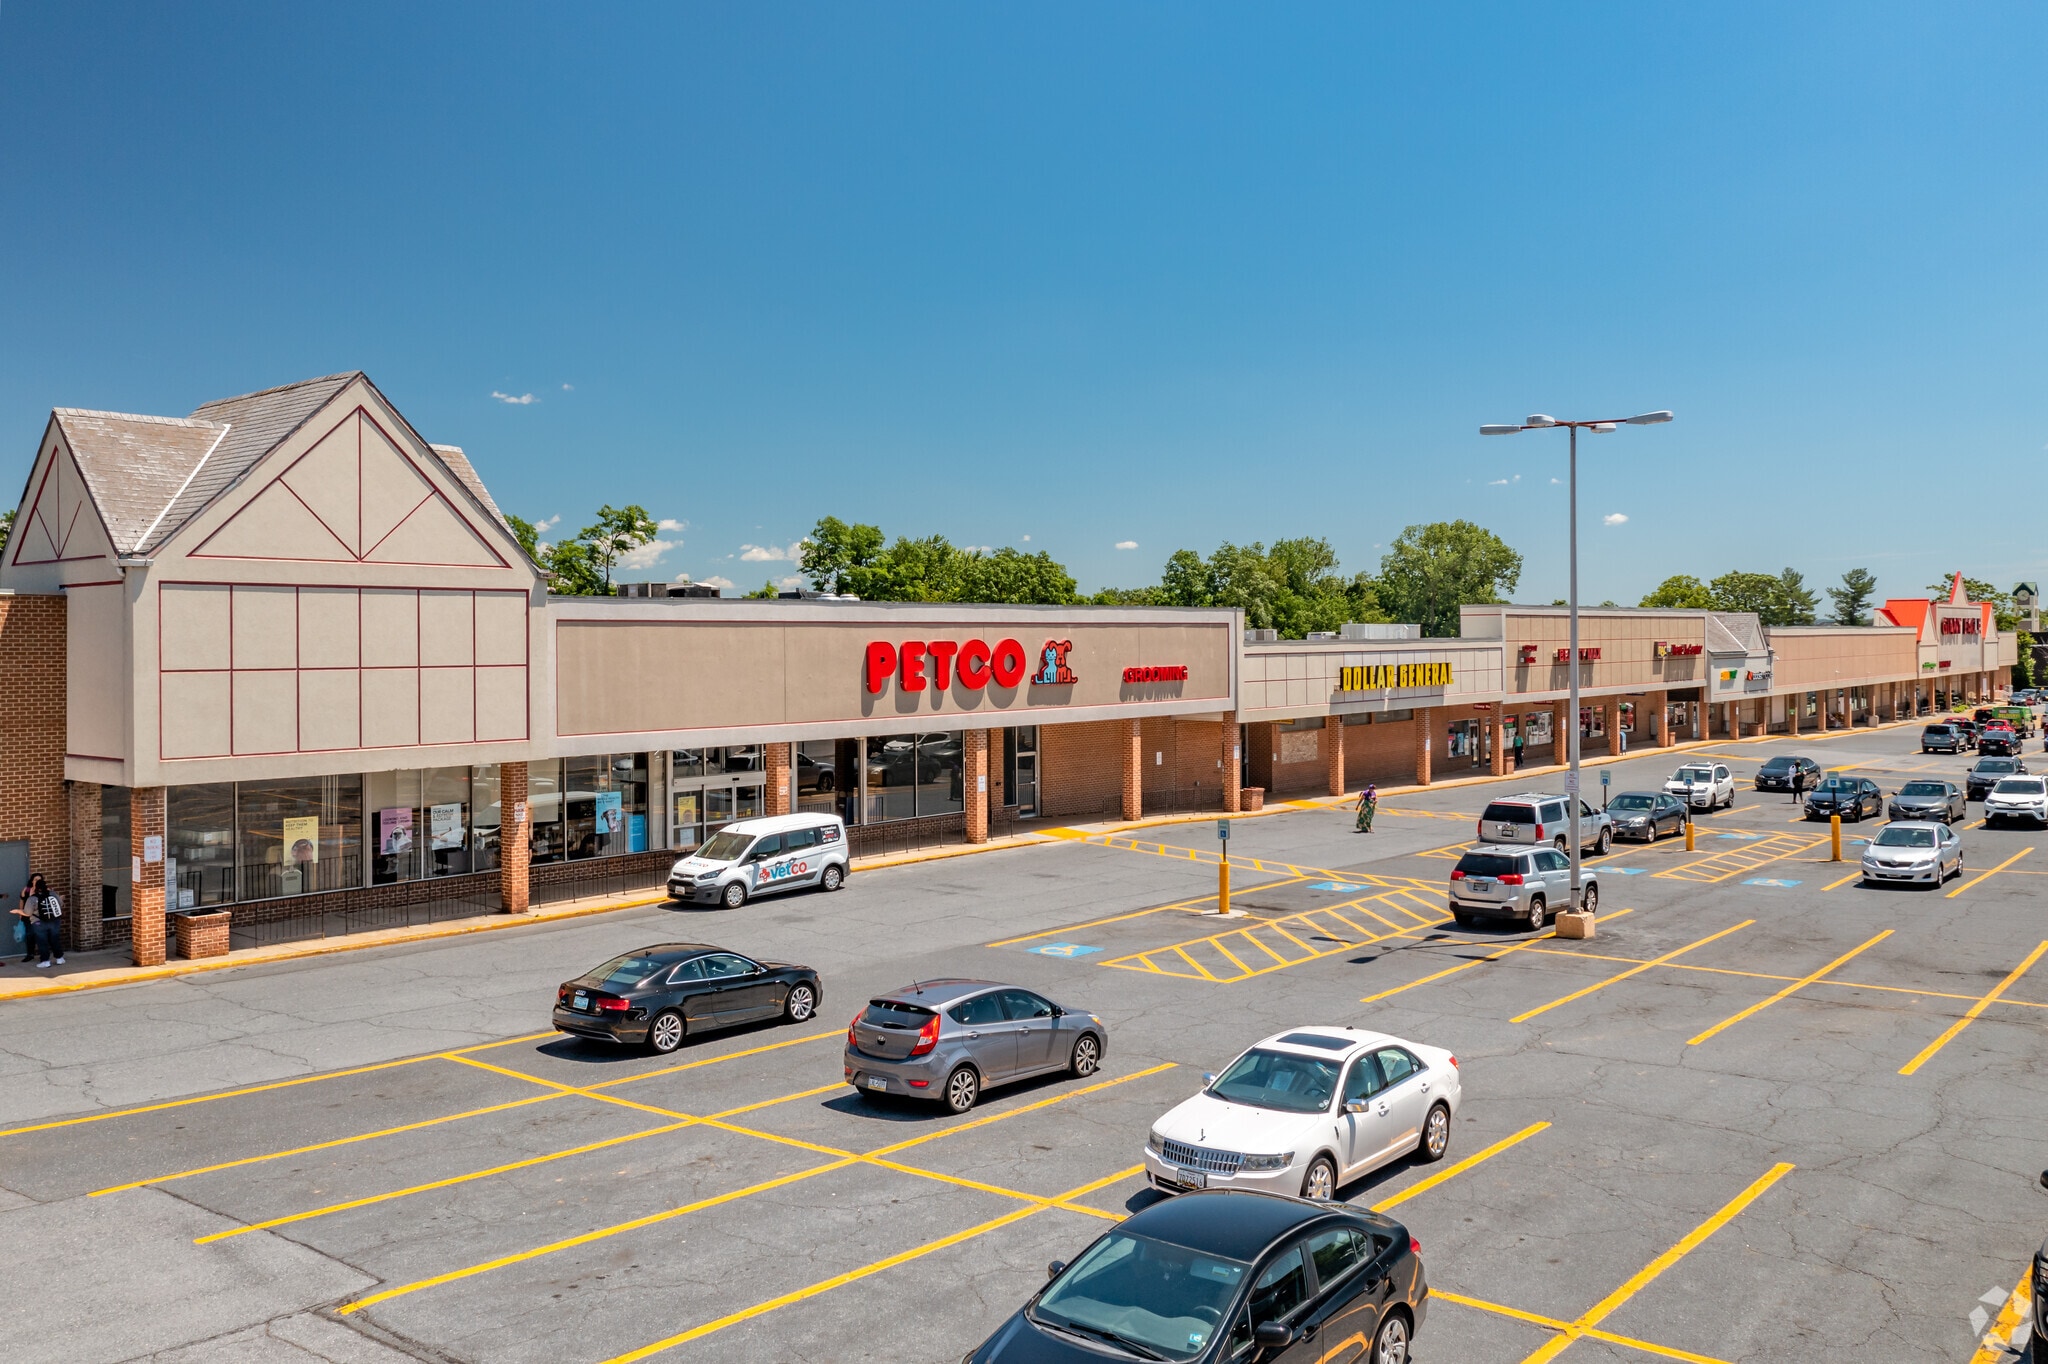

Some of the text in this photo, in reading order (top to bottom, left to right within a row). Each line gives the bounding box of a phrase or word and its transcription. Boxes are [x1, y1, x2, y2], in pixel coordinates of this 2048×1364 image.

[866, 639, 1027, 694] PETCO
[1123, 666, 1188, 683] GROOMING
[1341, 662, 1454, 691] DOLLAR GENERAL
[770, 861, 808, 880] vetco
